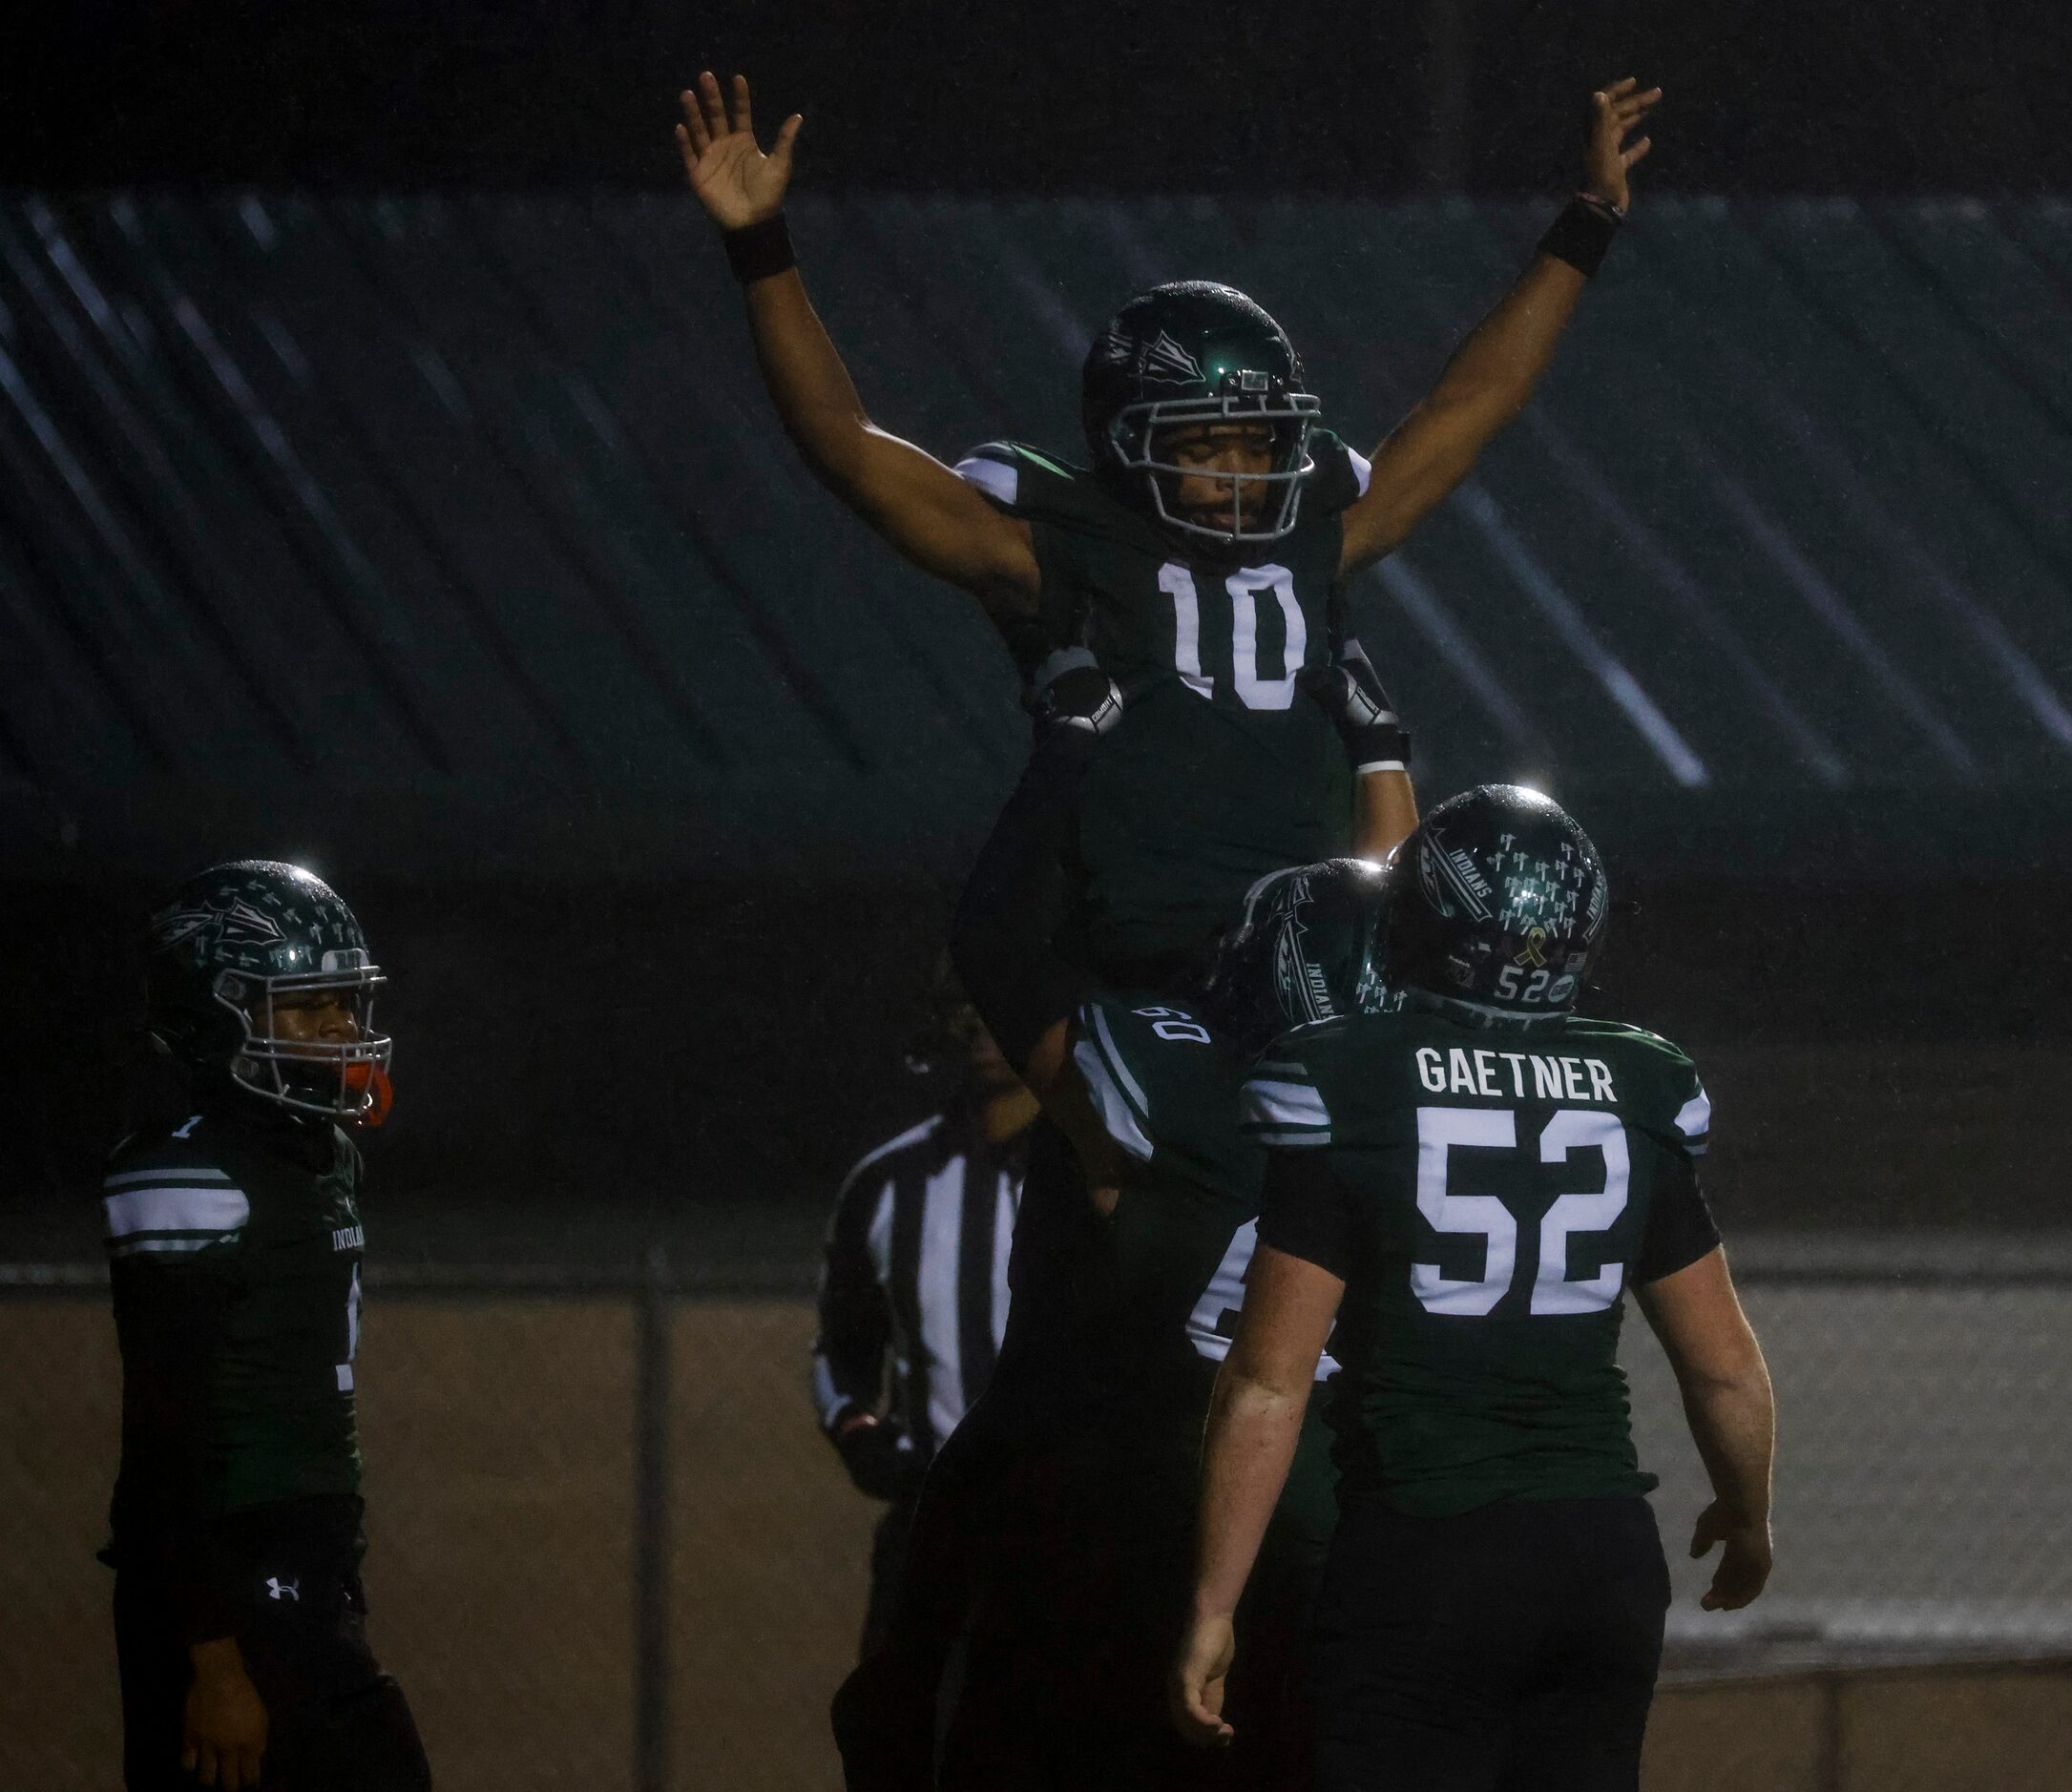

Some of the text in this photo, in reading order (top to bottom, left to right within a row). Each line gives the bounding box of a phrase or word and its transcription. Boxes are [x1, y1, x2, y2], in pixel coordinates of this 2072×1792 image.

[1158, 561, 1308, 710] 10
[1449, 848, 1494, 899] INDIANS
[1306, 963, 1335, 1019] INDIAN
[1493, 965, 1551, 1003] 52
[1130, 1006, 1212, 1045] 60
[1414, 1047, 1619, 1103] GAETNER
[1410, 1106, 1631, 1317] 52
